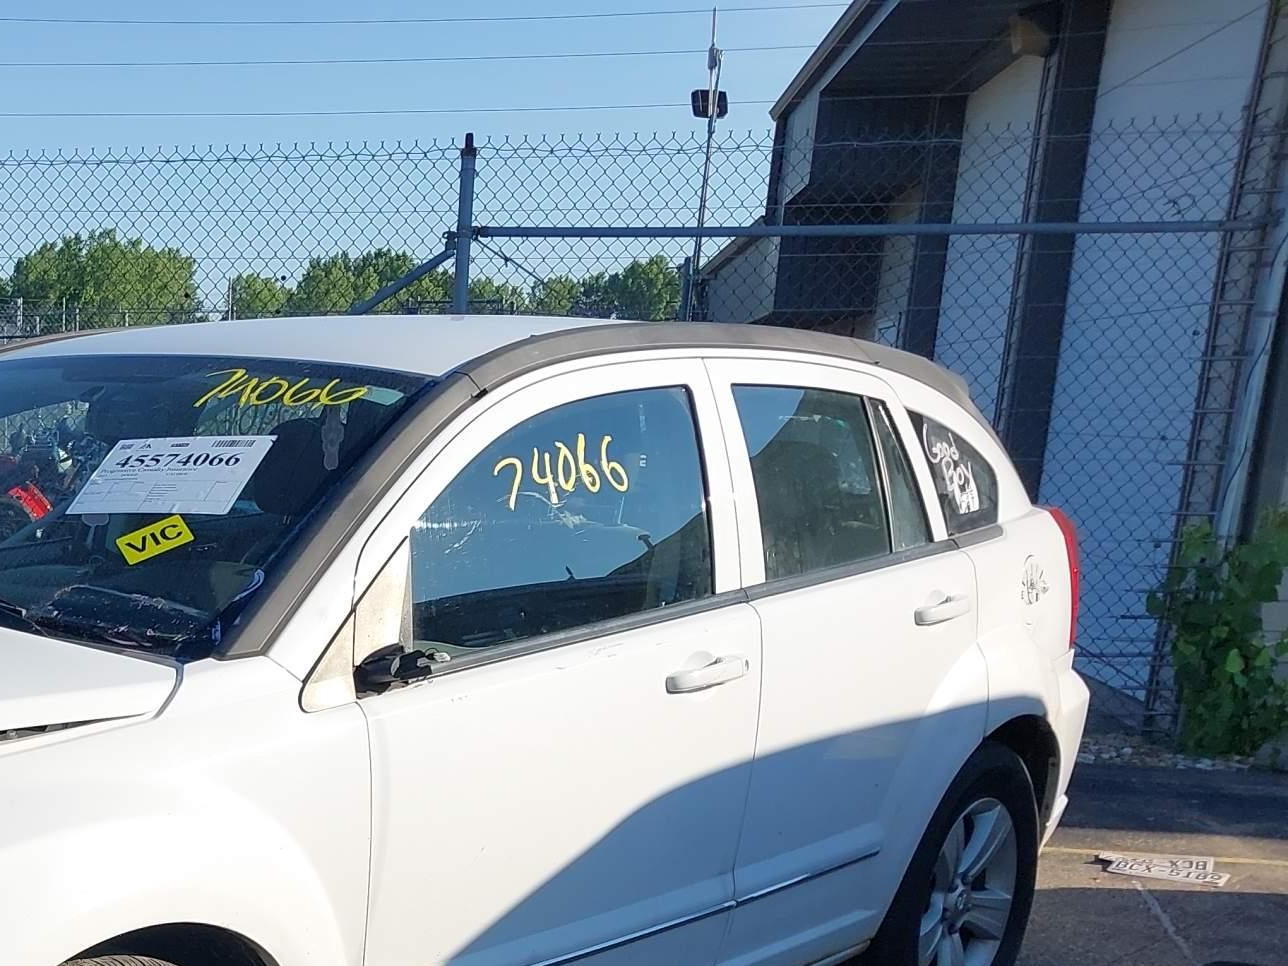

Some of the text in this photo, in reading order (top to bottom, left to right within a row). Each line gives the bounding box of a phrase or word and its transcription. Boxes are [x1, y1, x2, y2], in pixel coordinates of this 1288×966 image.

[115, 452, 245, 469] 45574066
[922, 423, 960, 464] Good
[493, 433, 629, 511] 74066
[941, 458, 973, 492] Boy
[125, 524, 183, 553] VIC
